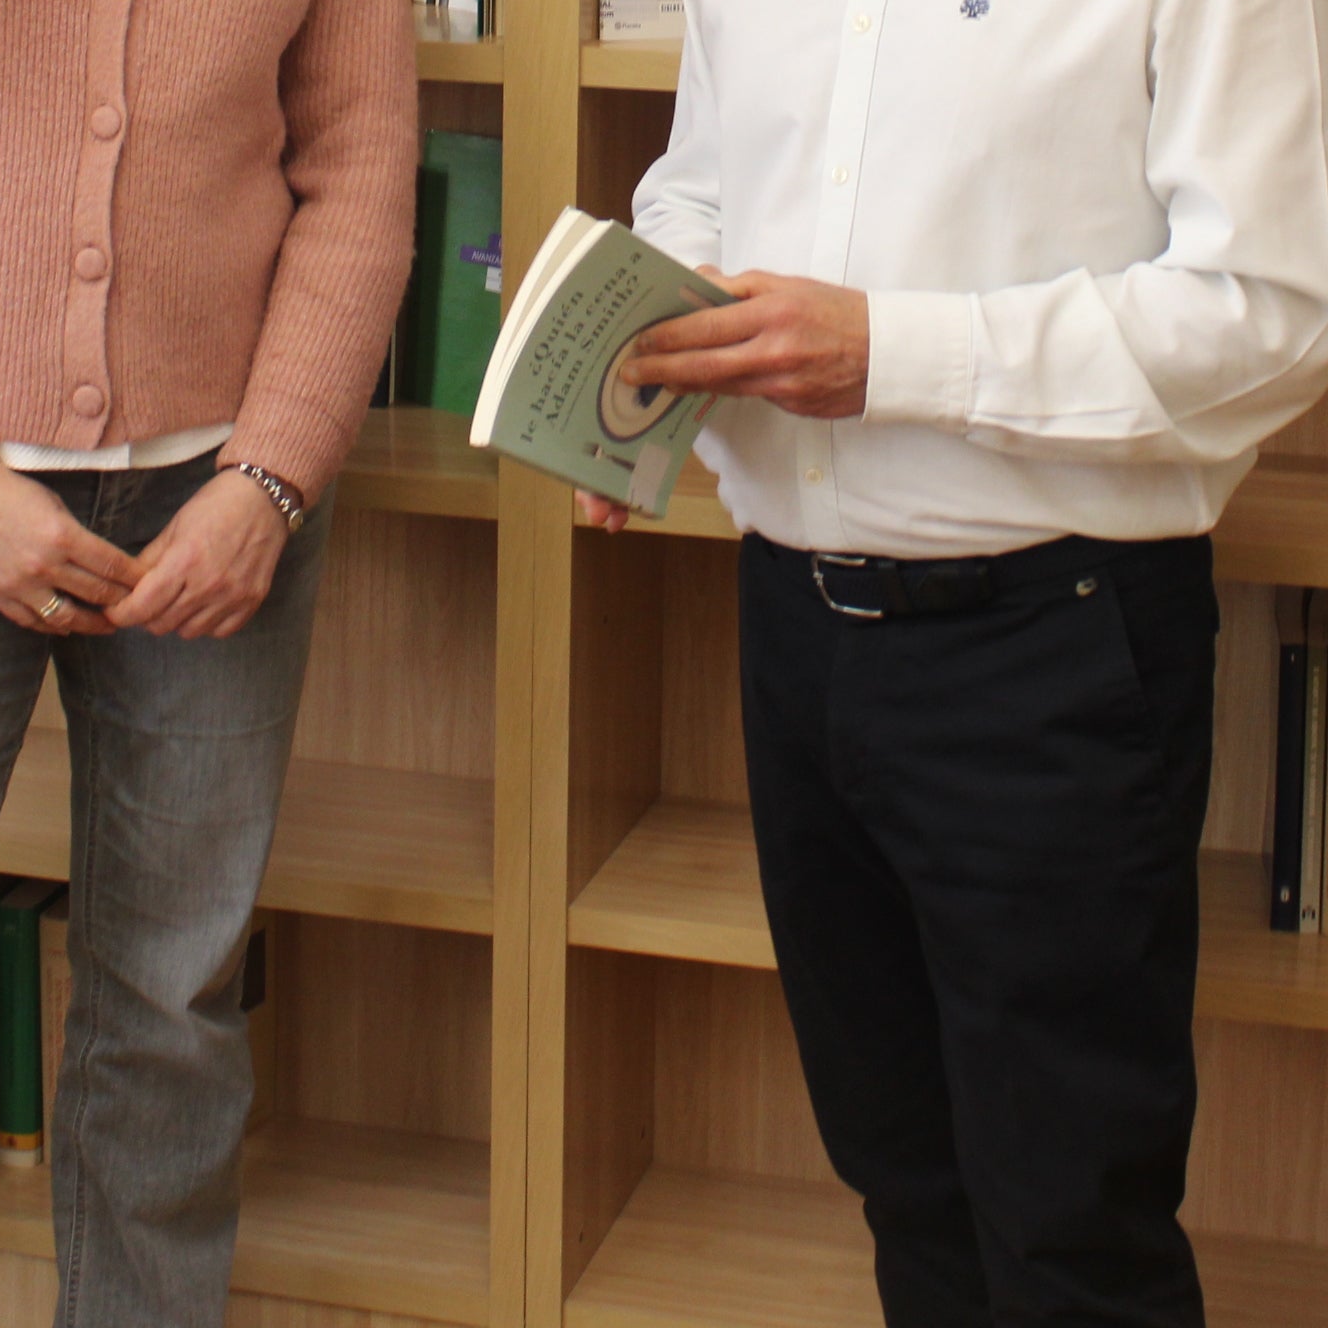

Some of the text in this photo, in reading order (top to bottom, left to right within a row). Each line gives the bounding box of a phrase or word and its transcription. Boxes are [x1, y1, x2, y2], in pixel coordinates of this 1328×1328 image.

[471, 250, 500, 264] AVANZA
[520, 251, 643, 444] le hacía la cena a
[529, 289, 584, 377] ¿Quién
[545, 274, 640, 429] Adam Smith?
